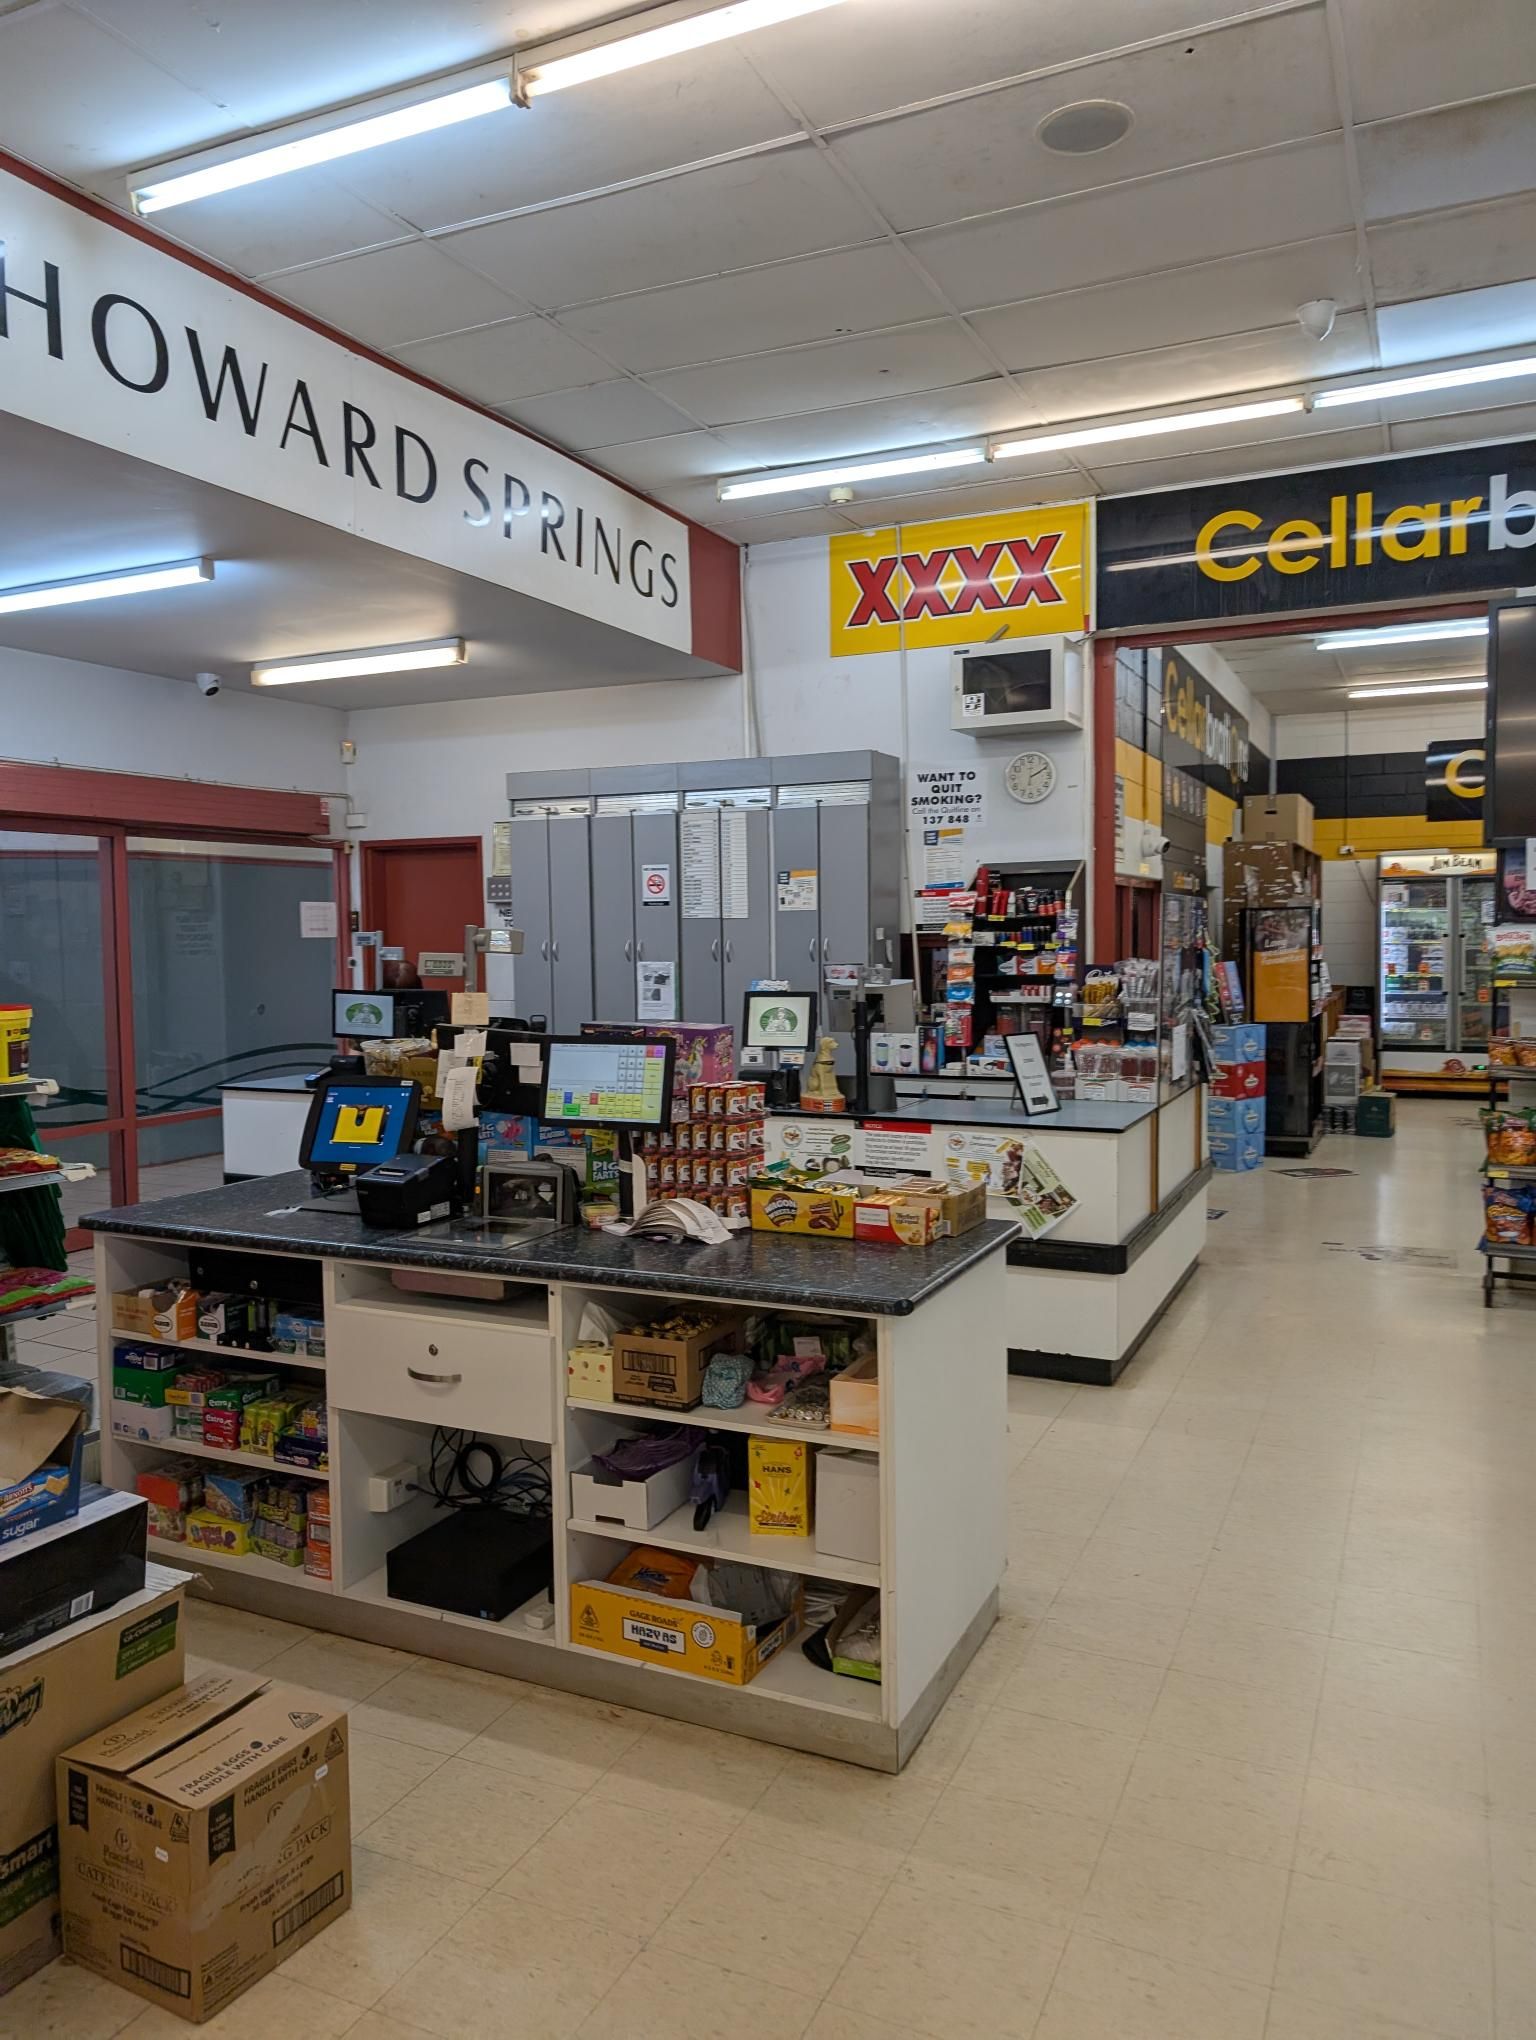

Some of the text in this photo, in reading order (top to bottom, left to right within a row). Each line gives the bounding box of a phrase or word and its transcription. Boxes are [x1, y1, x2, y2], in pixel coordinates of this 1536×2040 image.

[0, 240, 679, 609] HOWARD SPRINGS
[844, 531, 1064, 629] XXXX
[917, 771, 976, 783] WANT TO
[931, 783, 962, 794] QUIT
[911, 794, 982, 806] SMOKING?
[912, 807, 926, 815] Call
[941, 806, 969, 814] Quitline
[922, 814, 970, 825] 137 848
[1452, 854, 1482, 869] BEAM
[762, 1465, 792, 1474] HANS
[2, 1517, 40, 1540] sugar
[629, 1609, 678, 1628] GAGE ROADS
[631, 1624, 661, 1641] HAZY
[179, 1749, 252, 1794] FRAGILE EGGS
[188, 1735, 289, 1798] HANDLE WITH CARE
[244, 1753, 319, 1807] HANDLE WITH CARE
[244, 1769, 277, 1795] FRAGILE
[293, 1823, 329, 1854] PACK
